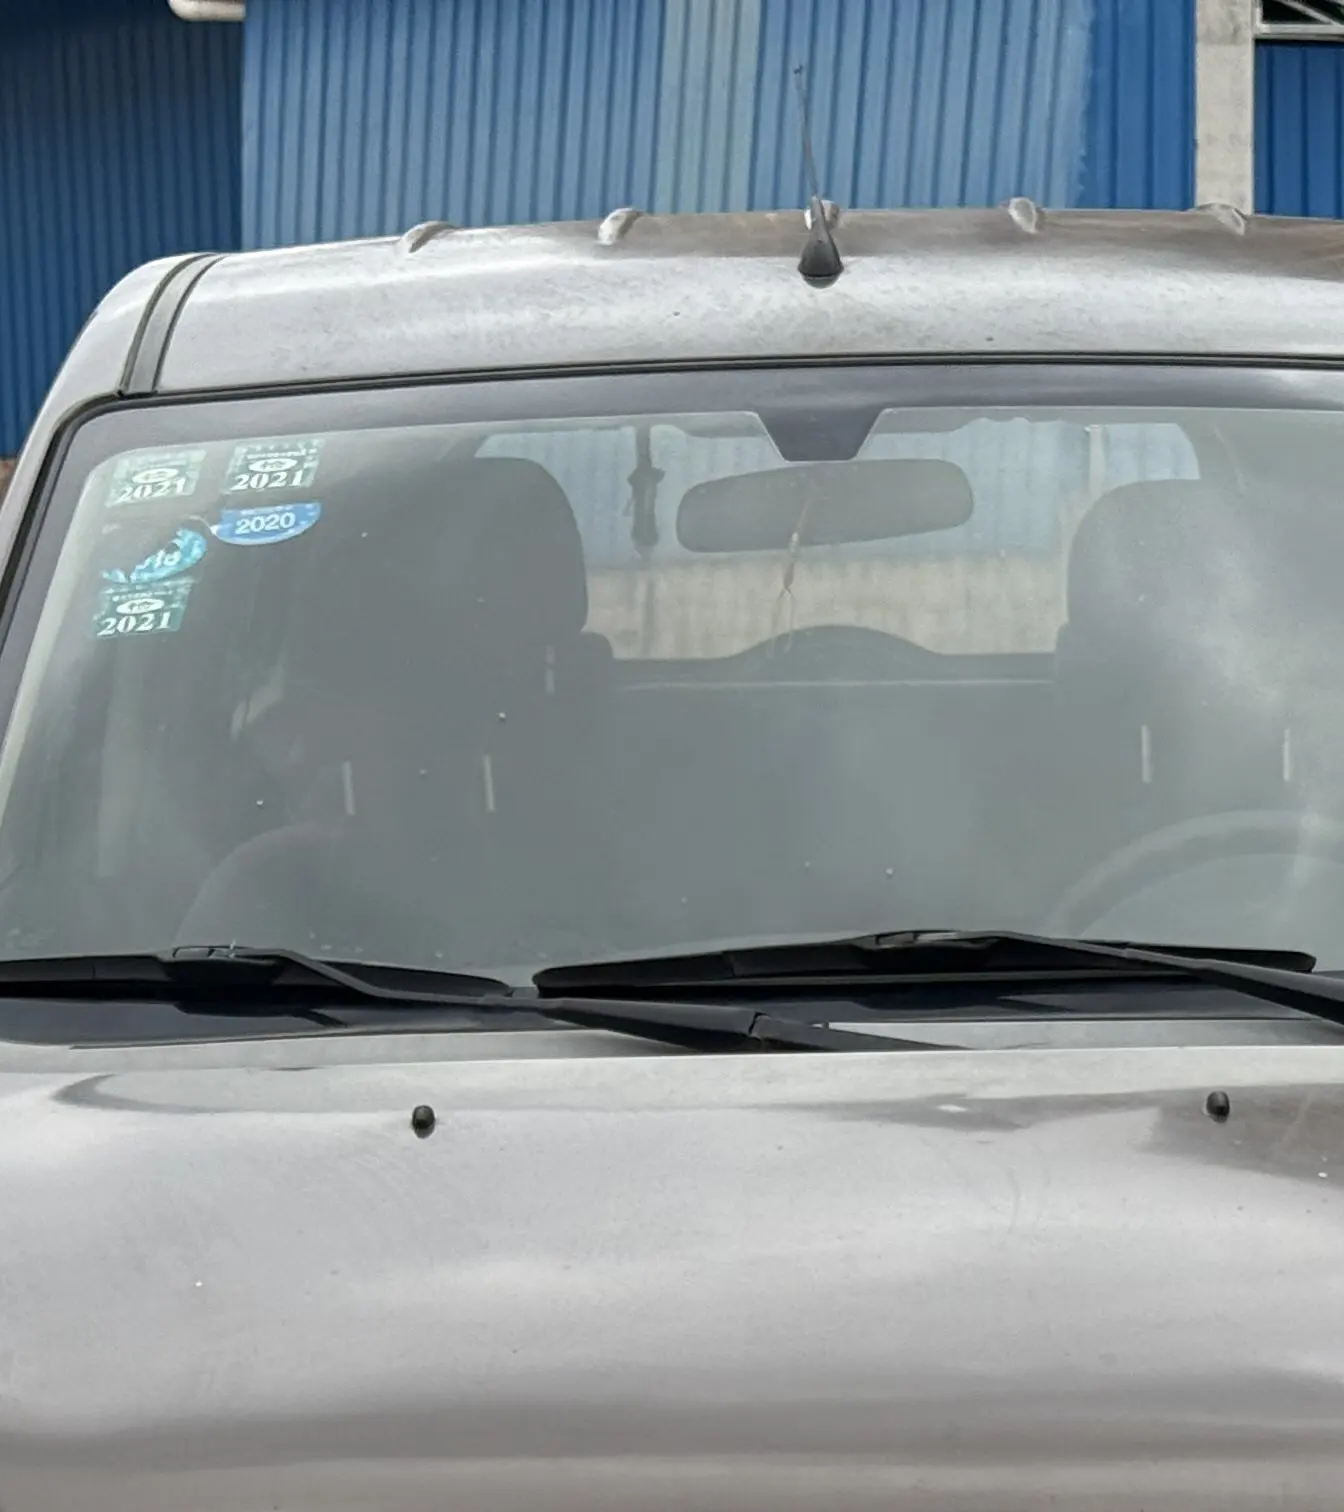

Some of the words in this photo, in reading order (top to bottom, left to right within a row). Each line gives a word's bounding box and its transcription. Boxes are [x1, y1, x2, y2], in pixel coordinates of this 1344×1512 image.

[116, 478, 188, 503] 2021
[231, 469, 304, 491] 2021
[235, 511, 296, 535] 2020
[97, 611, 171, 636] 2021
